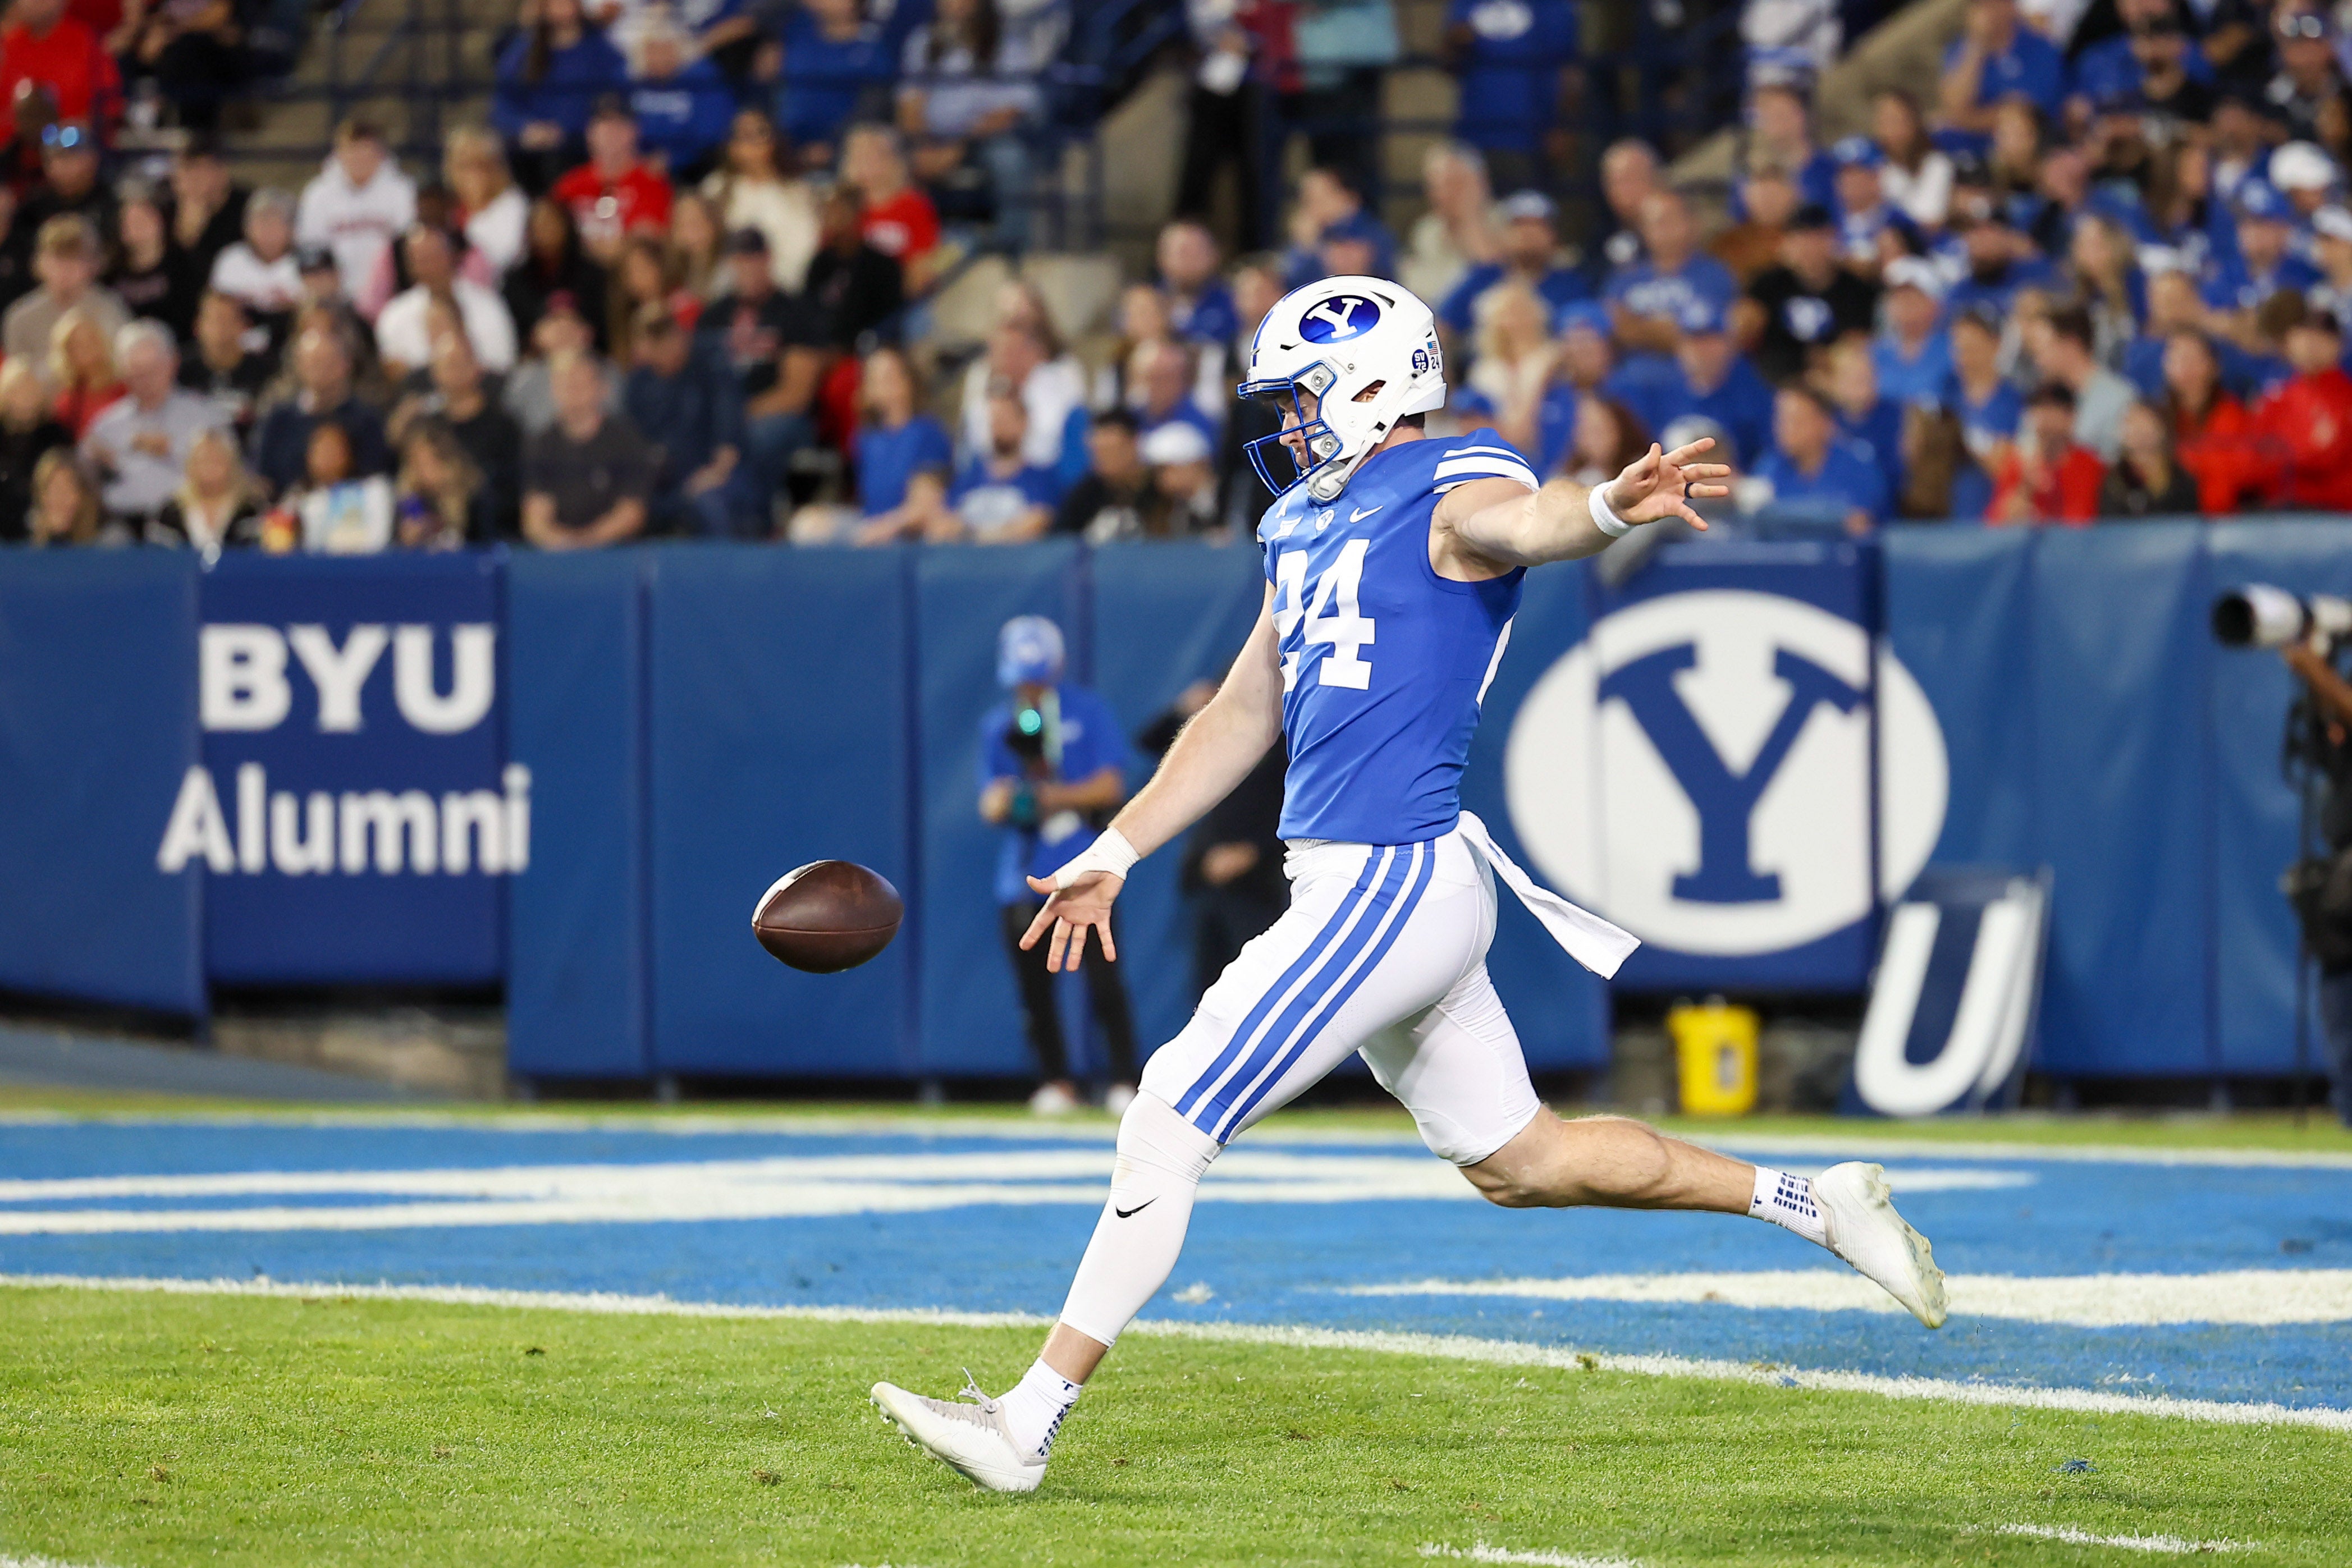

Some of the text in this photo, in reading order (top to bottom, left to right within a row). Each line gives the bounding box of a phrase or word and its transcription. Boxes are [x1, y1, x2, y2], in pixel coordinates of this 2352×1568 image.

[1305, 297, 1364, 339] Y
[1414, 352, 1425, 362] SV
[1416, 361, 1427, 371] 72
[1431, 356, 1440, 369] 24
[198, 622, 497, 735] BYU
[1596, 640, 1870, 905] Y
[157, 761, 532, 876] Alumni
[1855, 888, 2035, 1115] U
